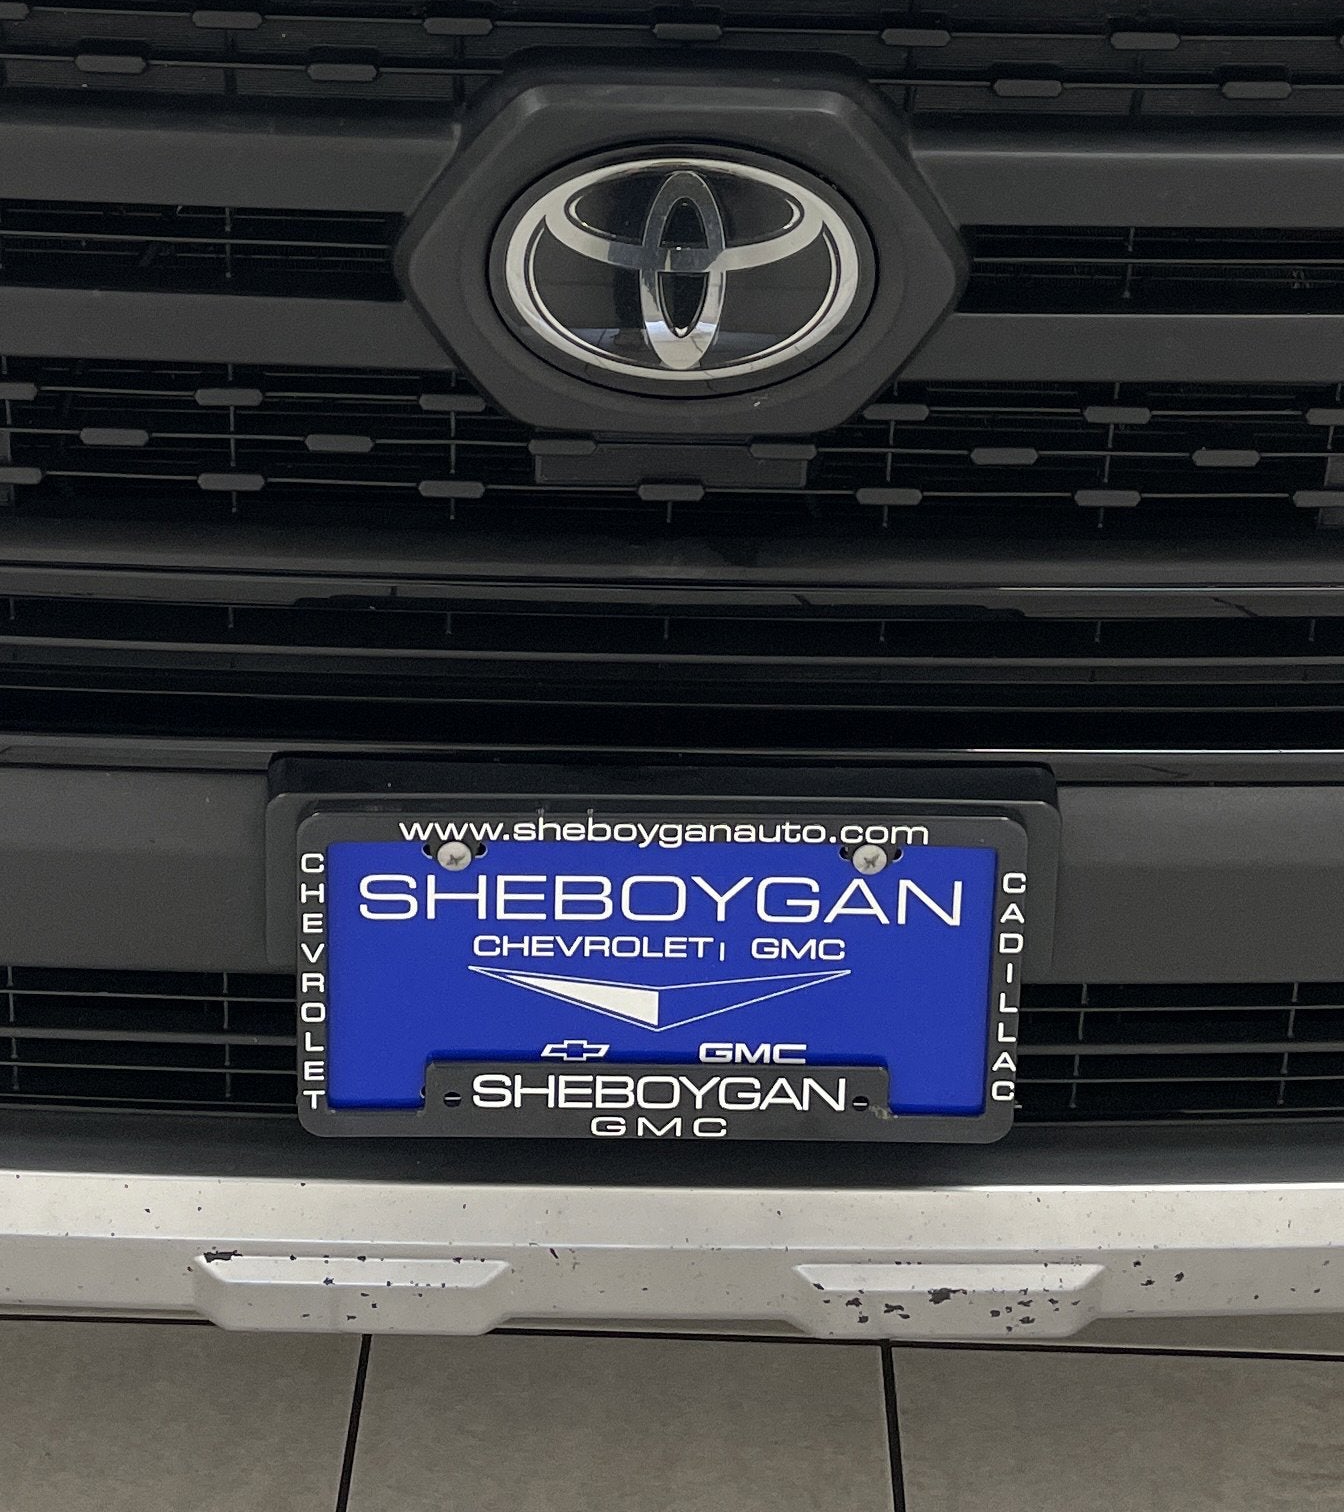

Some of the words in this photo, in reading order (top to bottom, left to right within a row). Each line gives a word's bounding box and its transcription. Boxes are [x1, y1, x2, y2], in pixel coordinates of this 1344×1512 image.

[399, 816, 929, 849] www.sheboyganauto.com
[359, 873, 963, 927] SHEBOYGAN
[750, 937, 847, 961] GMC
[300, 852, 326, 1110] CHEVROLET
[991, 871, 1028, 1103] CADILLAC
[698, 1042, 807, 1065] GMC
[472, 1073, 846, 1113] SHEBOYGAN
[590, 1116, 728, 1138] GMC
